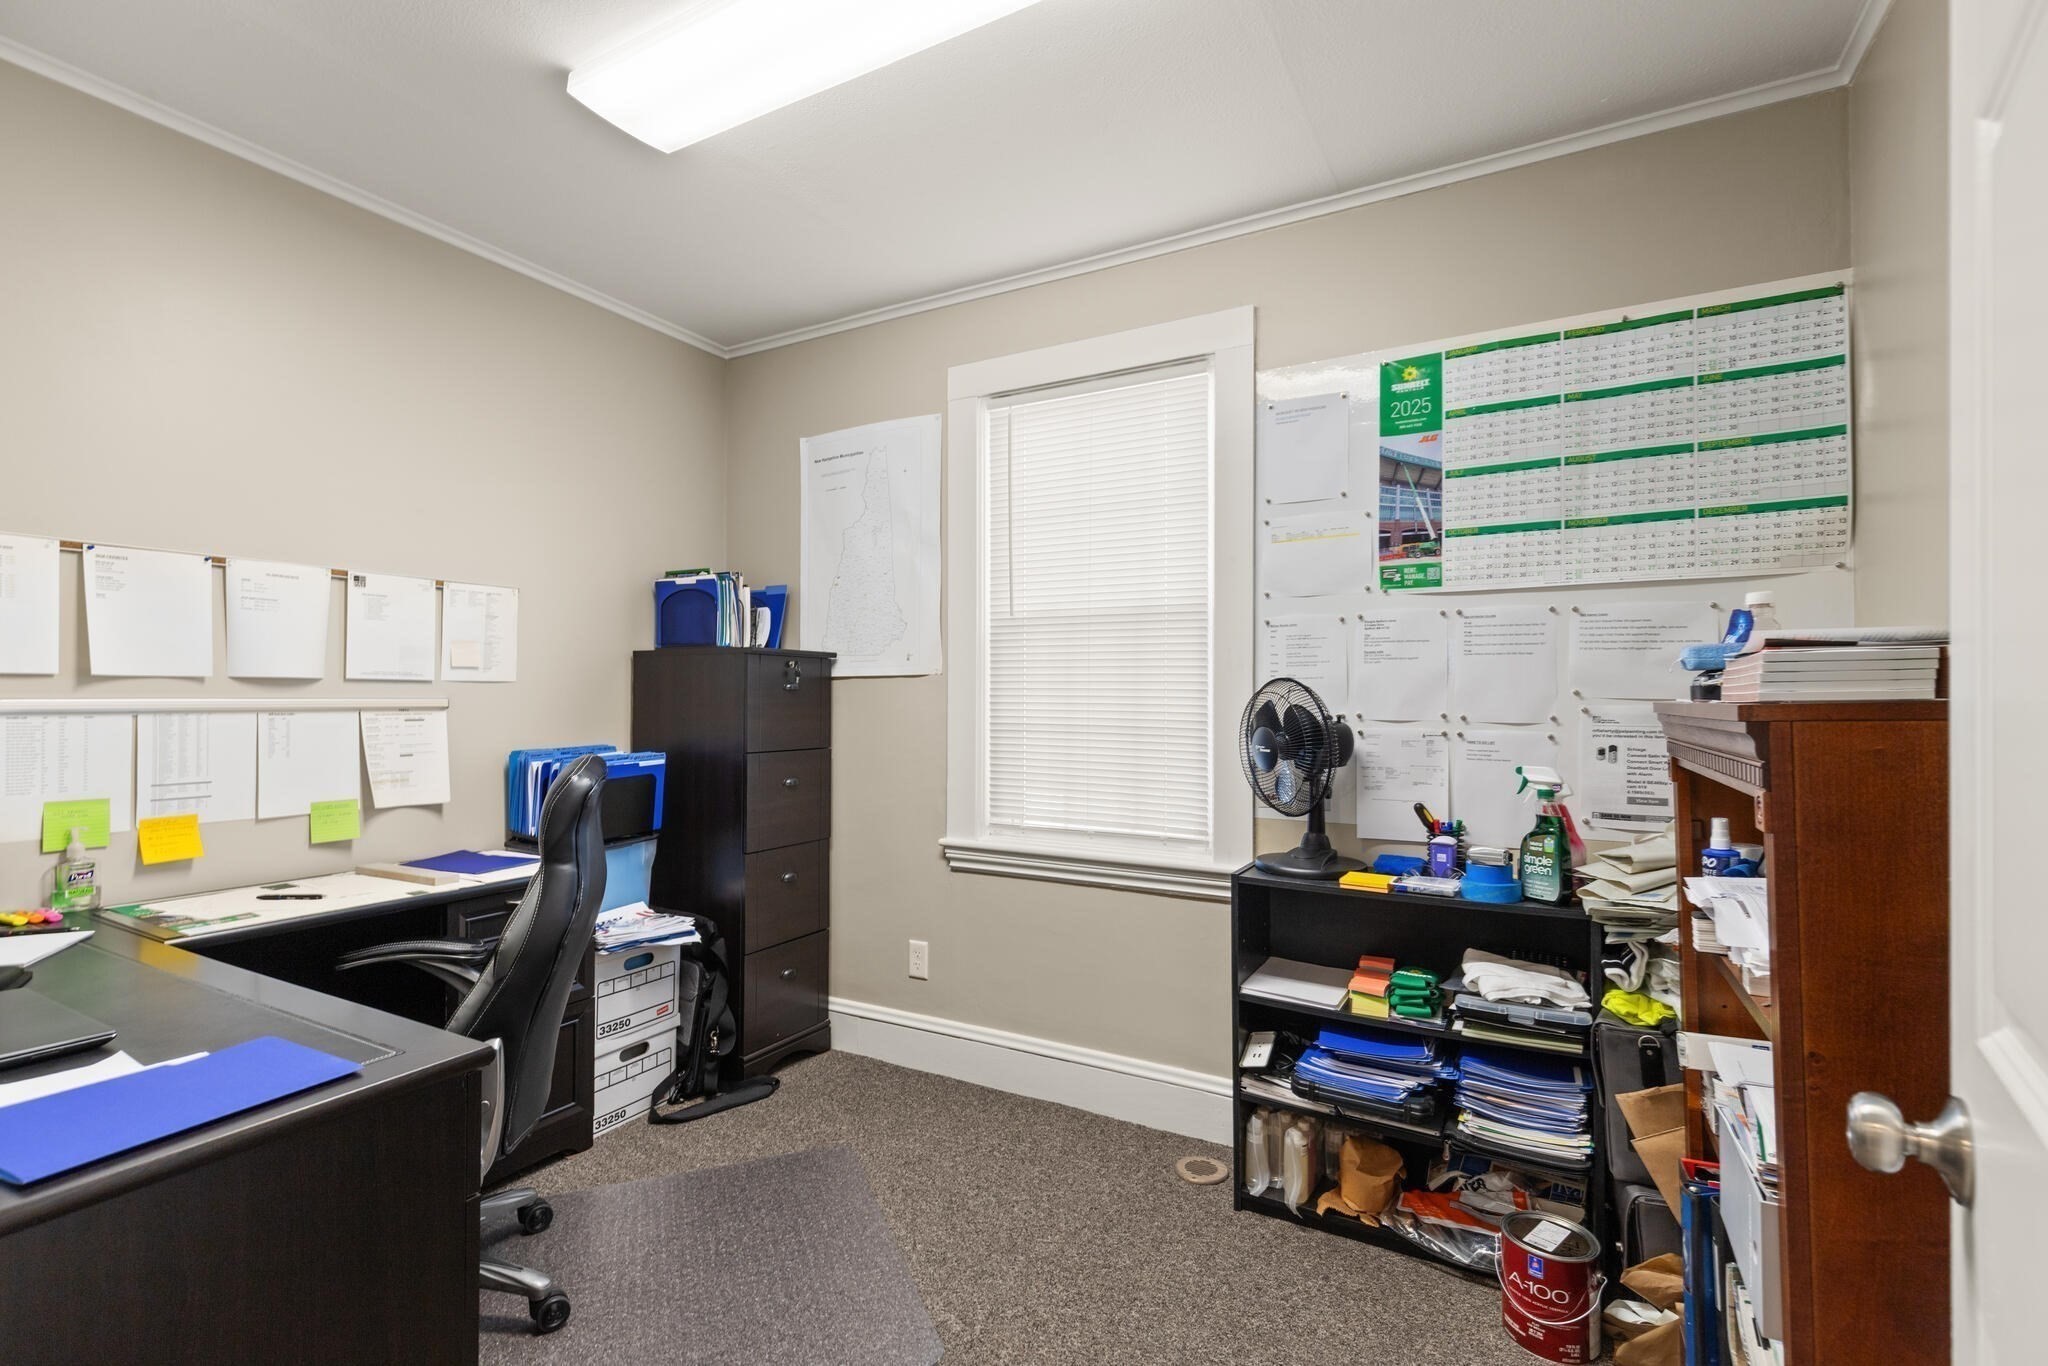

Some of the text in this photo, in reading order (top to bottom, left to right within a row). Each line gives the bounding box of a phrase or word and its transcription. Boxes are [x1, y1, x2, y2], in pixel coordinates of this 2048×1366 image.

[1390, 397, 1432, 418] 2025
[1704, 438, 1750, 448] SEPTEMBER
[1704, 505, 1747, 515] DECEMBER
[1524, 853, 1553, 866] simple
[1524, 864, 1552, 876] green
[600, 1018, 631, 1036] 33250
[595, 1110, 626, 1130] 33250
[1509, 1272, 1569, 1304] A-100
